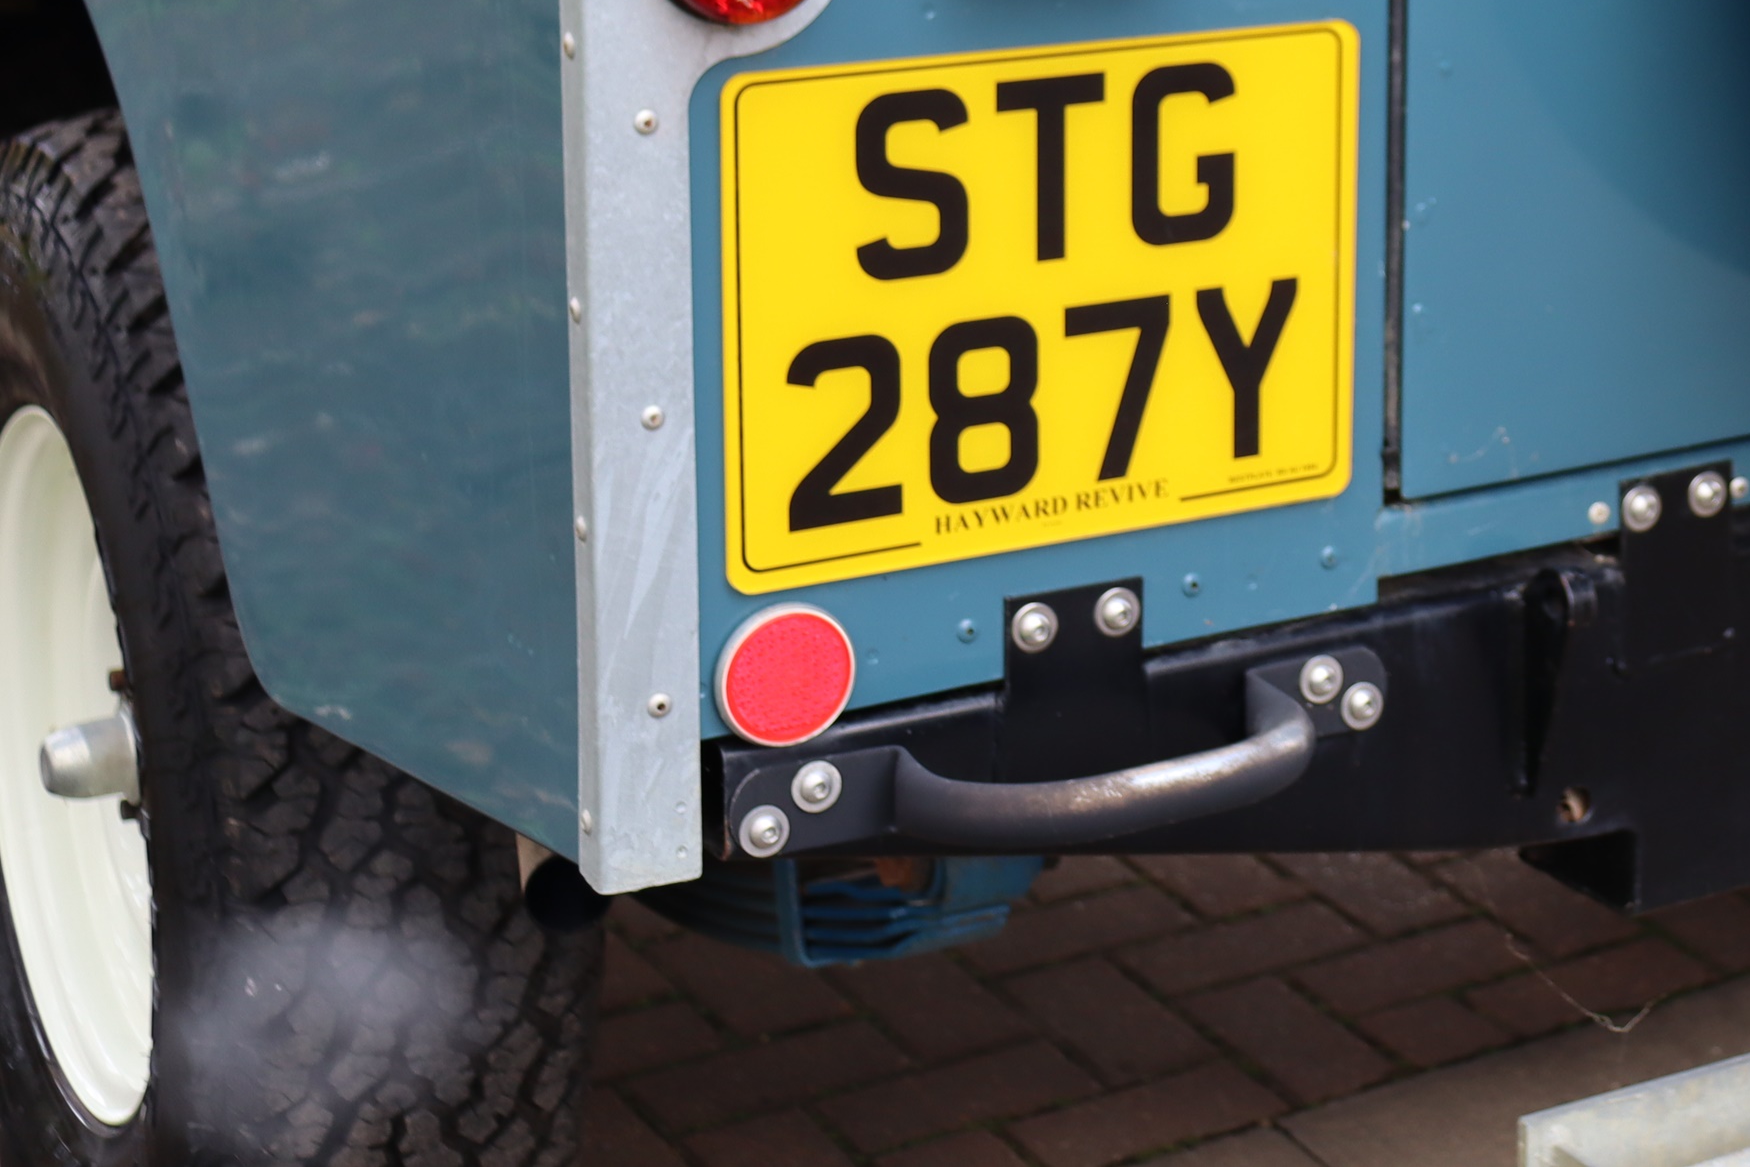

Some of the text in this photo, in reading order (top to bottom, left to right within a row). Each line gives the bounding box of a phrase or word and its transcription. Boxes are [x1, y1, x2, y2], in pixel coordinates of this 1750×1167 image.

[855, 61, 1236, 281] STG
[786, 276, 1299, 533] 287Y
[935, 478, 1169, 535] HAYWARD REVIVE
